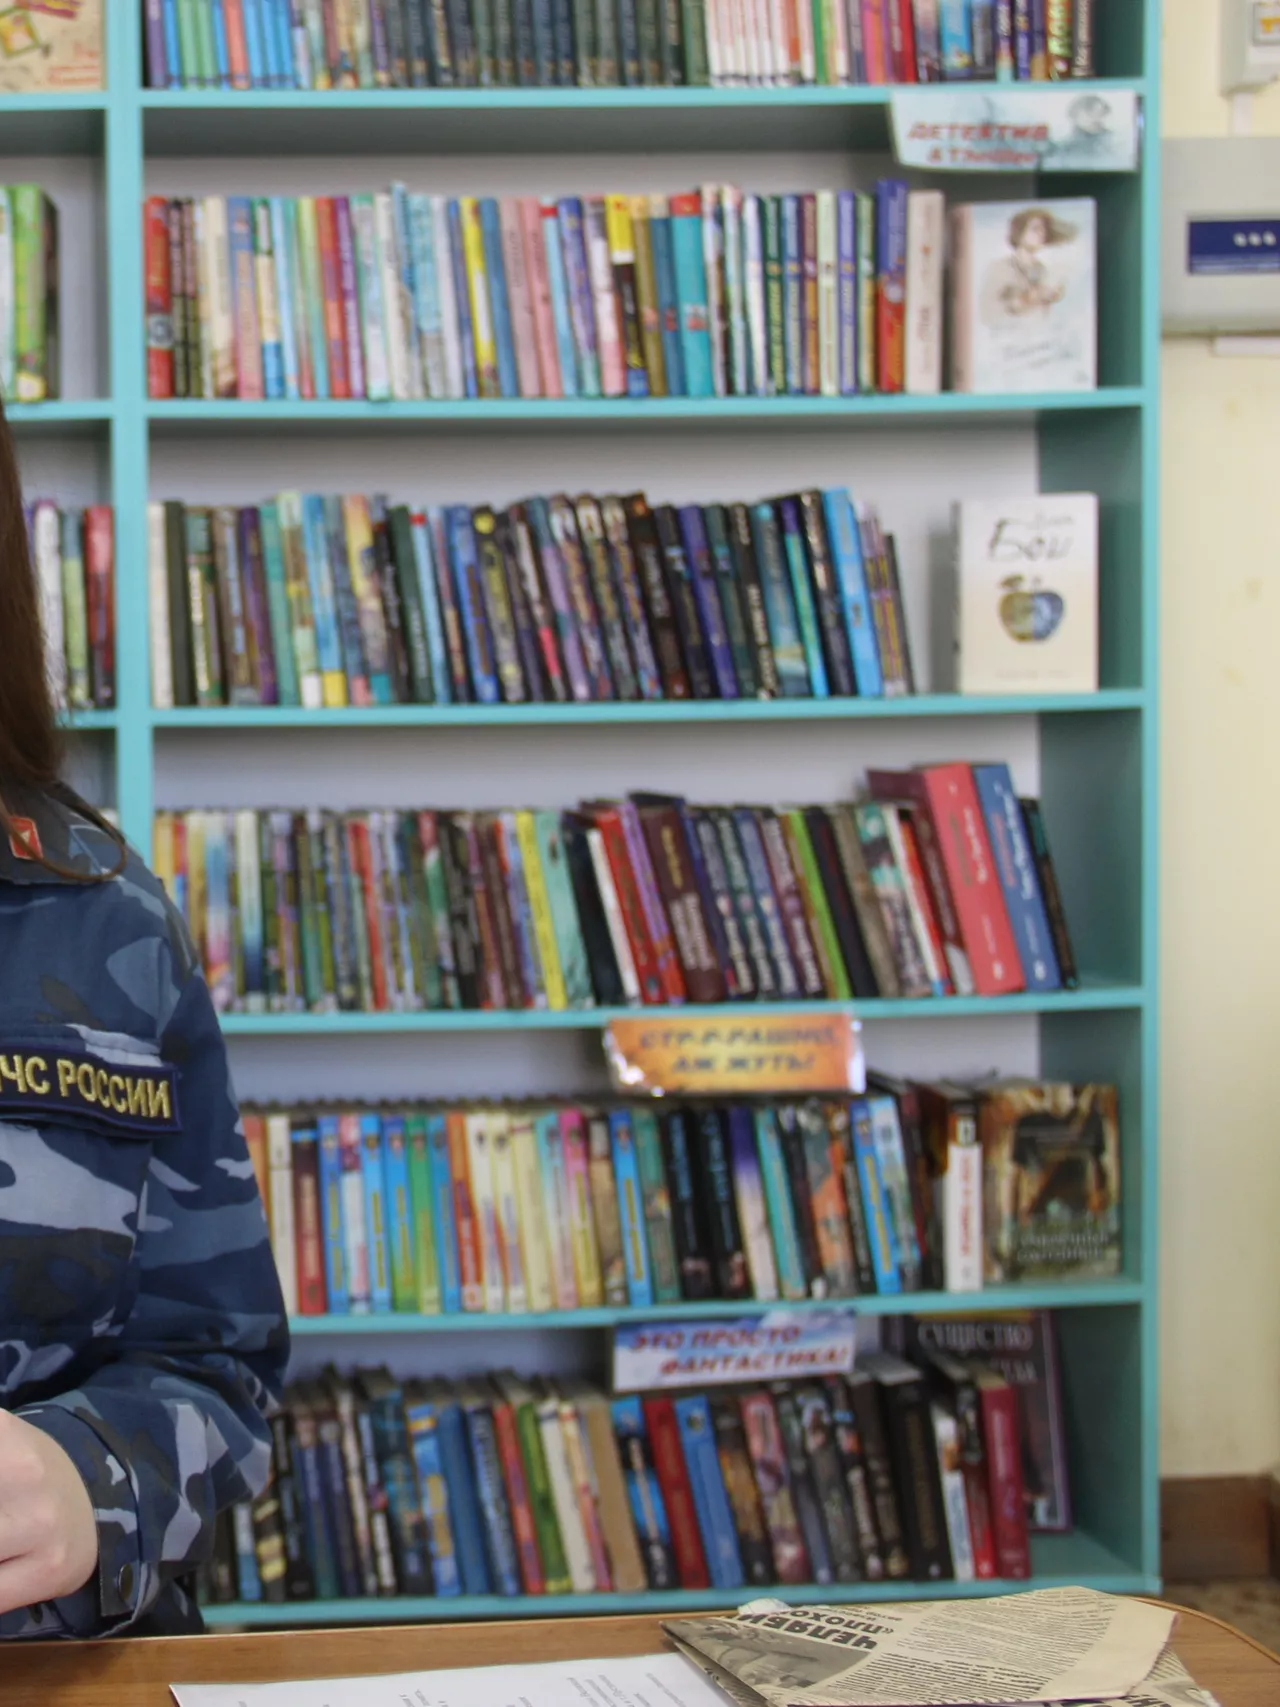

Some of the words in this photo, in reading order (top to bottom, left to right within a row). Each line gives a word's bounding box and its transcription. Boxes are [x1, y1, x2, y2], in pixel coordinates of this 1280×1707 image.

[907, 123, 1050, 141] ДЕТЕКТИВ
[56, 1058, 171, 1119] РОССИИ
[631, 1329, 685, 1350] ЭТО
[691, 1326, 801, 1347] ПРОСТО
[660, 1347, 848, 1376] ФАНТАСТИКА!
[730, 1613, 878, 1650] ЧЕЛЯБИ
